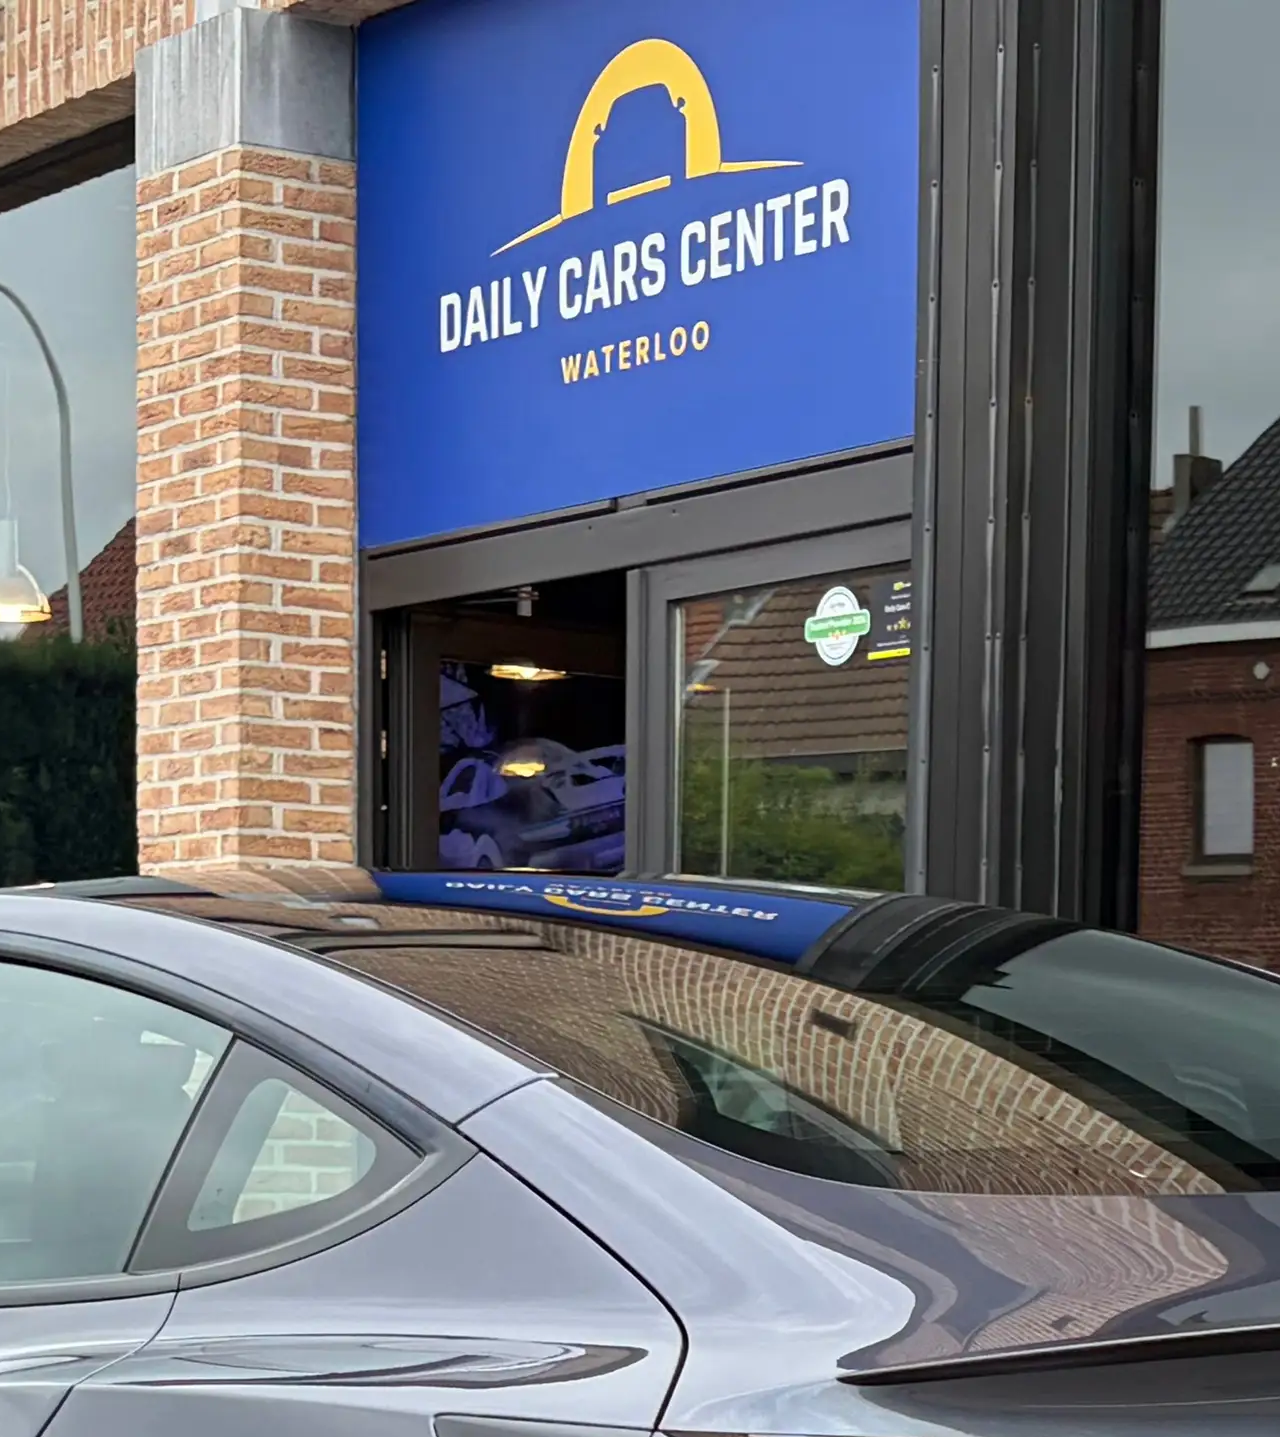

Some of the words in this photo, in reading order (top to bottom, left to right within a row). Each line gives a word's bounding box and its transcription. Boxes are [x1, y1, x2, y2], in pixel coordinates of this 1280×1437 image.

[439, 266, 548, 354] DAILY
[558, 232, 666, 320] CARS
[680, 178, 851, 286] CENTER
[561, 320, 711, 385] WATERLOO
